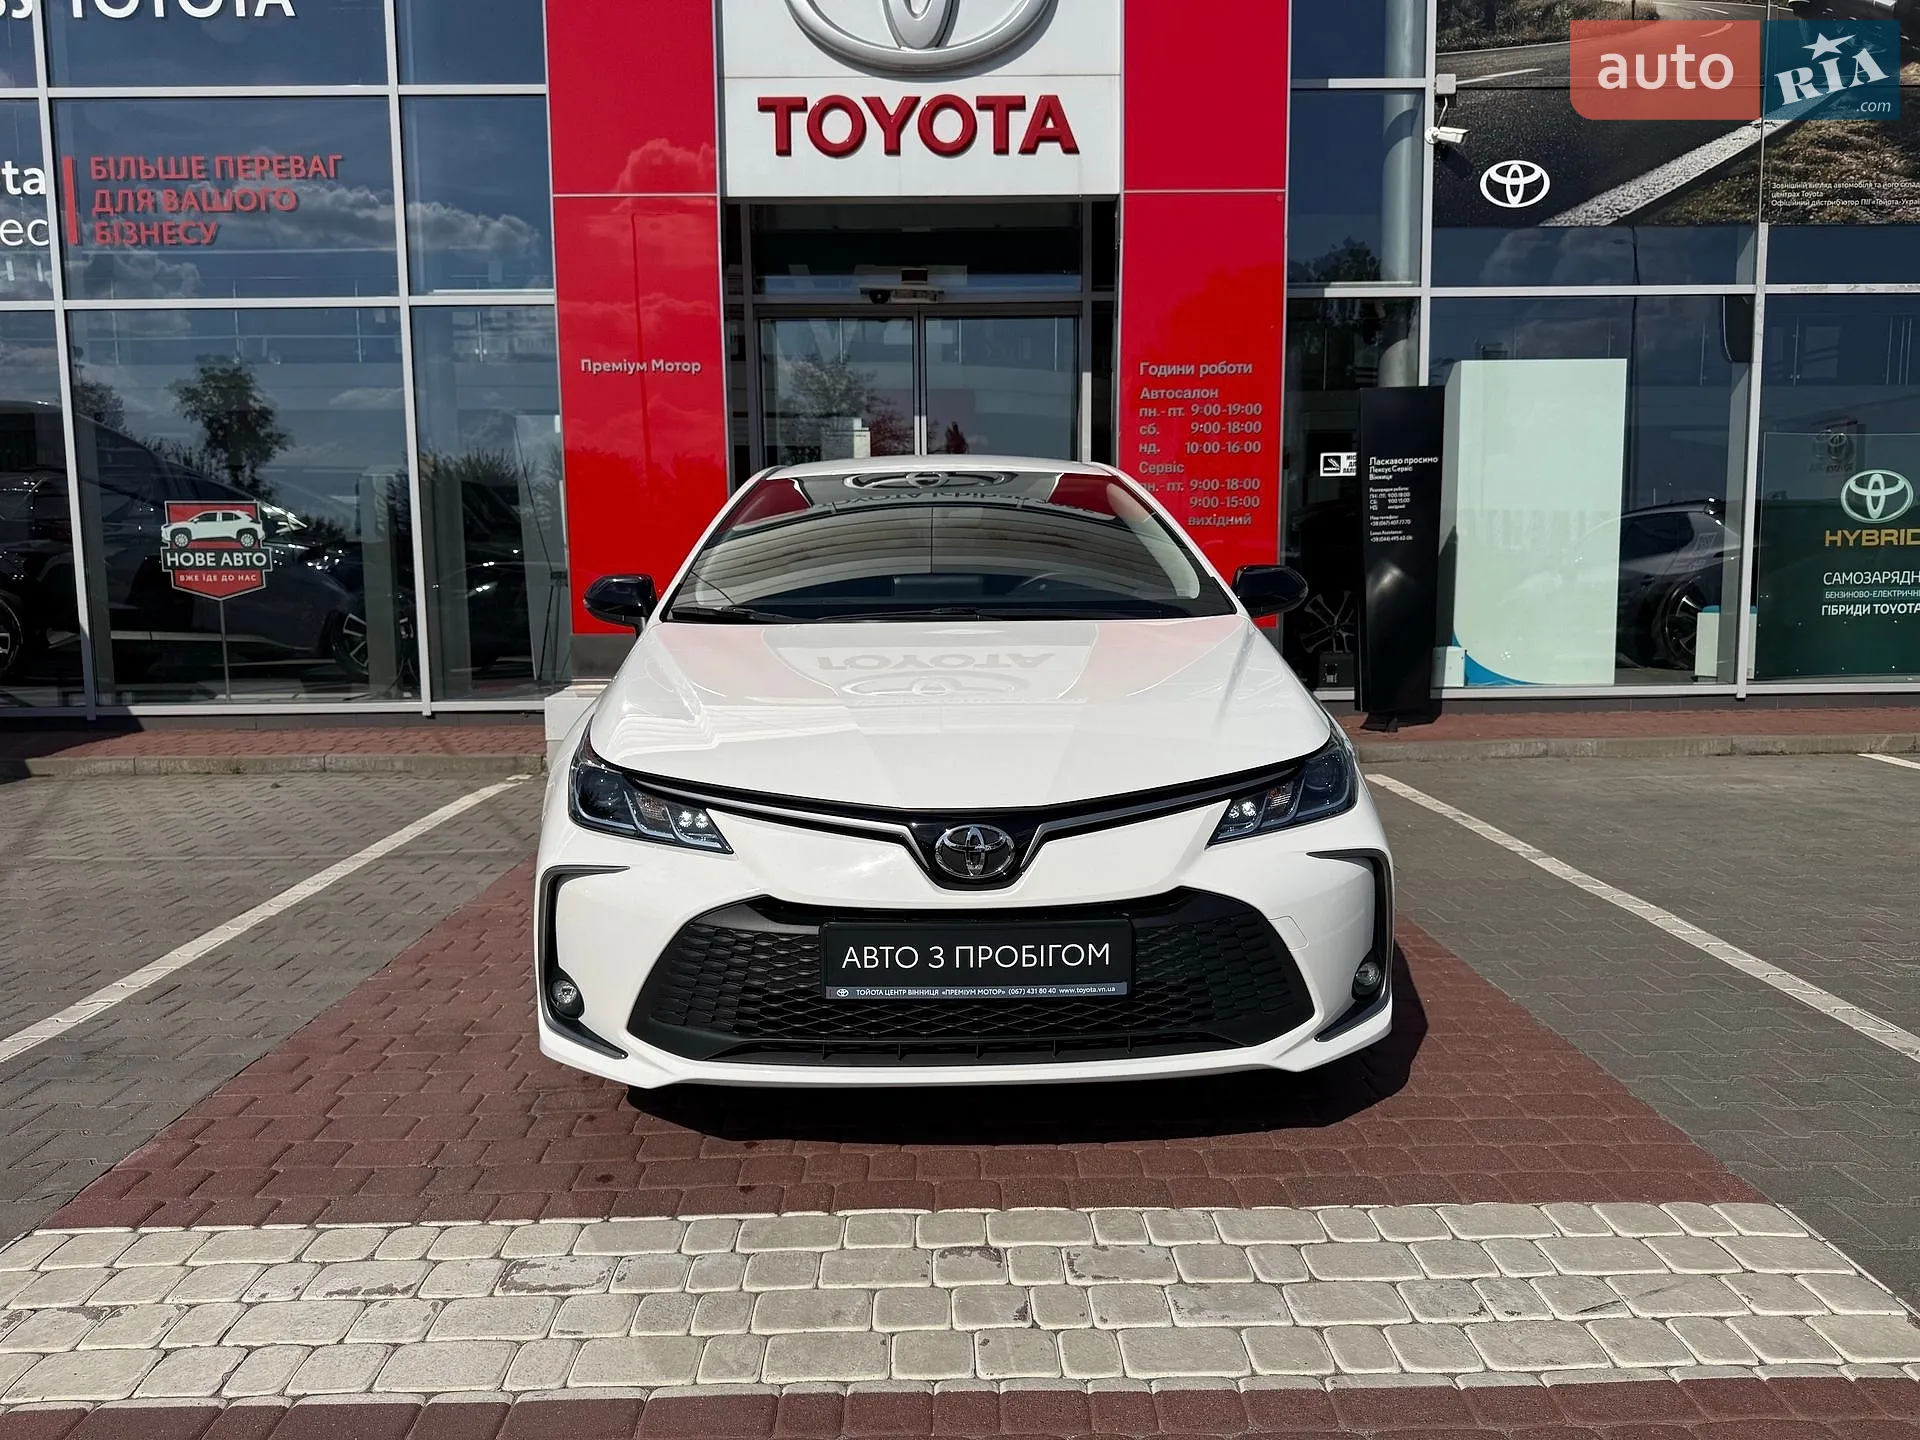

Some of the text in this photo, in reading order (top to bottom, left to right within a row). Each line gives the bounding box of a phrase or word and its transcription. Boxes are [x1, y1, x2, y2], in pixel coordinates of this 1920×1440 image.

[757, 94, 1080, 158] TOYOTA
[90, 154, 343, 180] БІЛЬШЕ ПЕРЕВАГ
[92, 188, 298, 217] ДЛЯ ВАШОГО
[95, 220, 218, 246] БІЗНЕСУ
[580, 358, 701, 375] Преміум Мотор
[1139, 360, 1253, 378] Години роботи
[1140, 387, 1219, 400] Автосалон
[1139, 423, 1160, 435] сб.
[1139, 443, 1160, 455] нд.
[1139, 460, 1185, 475] Сервіс
[1188, 512, 1252, 527] вихідний
[166, 552, 267, 567] НОВЕ АВТО
[179, 573, 257, 583] ВЖЕ ЇДЕ ДО НАС
[1821, 603, 1871, 616] ГІБРИДИ
[841, 946, 918, 969] АВТО
[954, 943, 1111, 968] ПРОБІГОМ
[856, 987, 883, 996] ТОЙОТА
[884, 988, 907, 997] ЦЕНТР
[907, 988, 939, 997] ВІННИЦЯ
[941, 988, 976, 996] «ПРЕМІУМ
[977, 988, 1006, 996] МОТОР»
[1008, 987, 1026, 996] (067)
[1058, 985, 1116, 995] www.toyota.vn.ua
